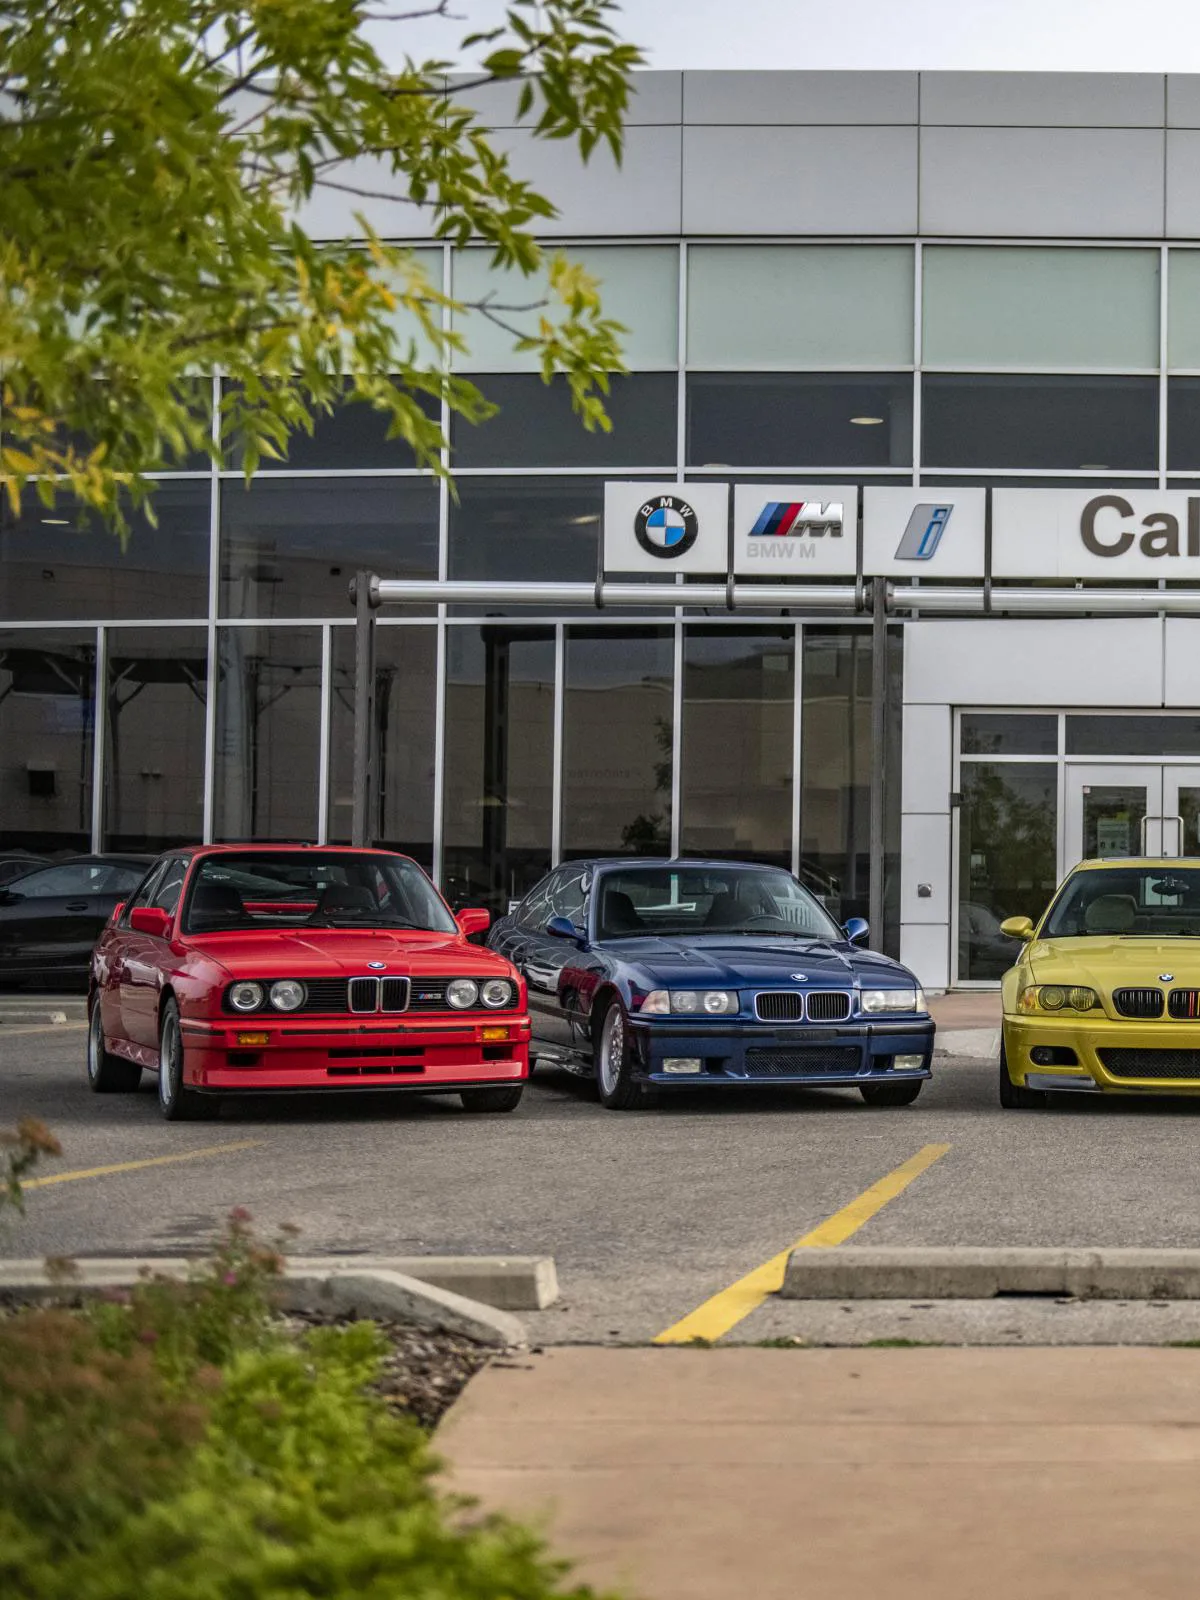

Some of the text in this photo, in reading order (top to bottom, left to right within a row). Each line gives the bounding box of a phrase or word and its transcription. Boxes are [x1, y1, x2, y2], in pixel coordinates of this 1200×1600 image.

[640, 497, 694, 518] BMW
[746, 542, 816, 559] BMW M
